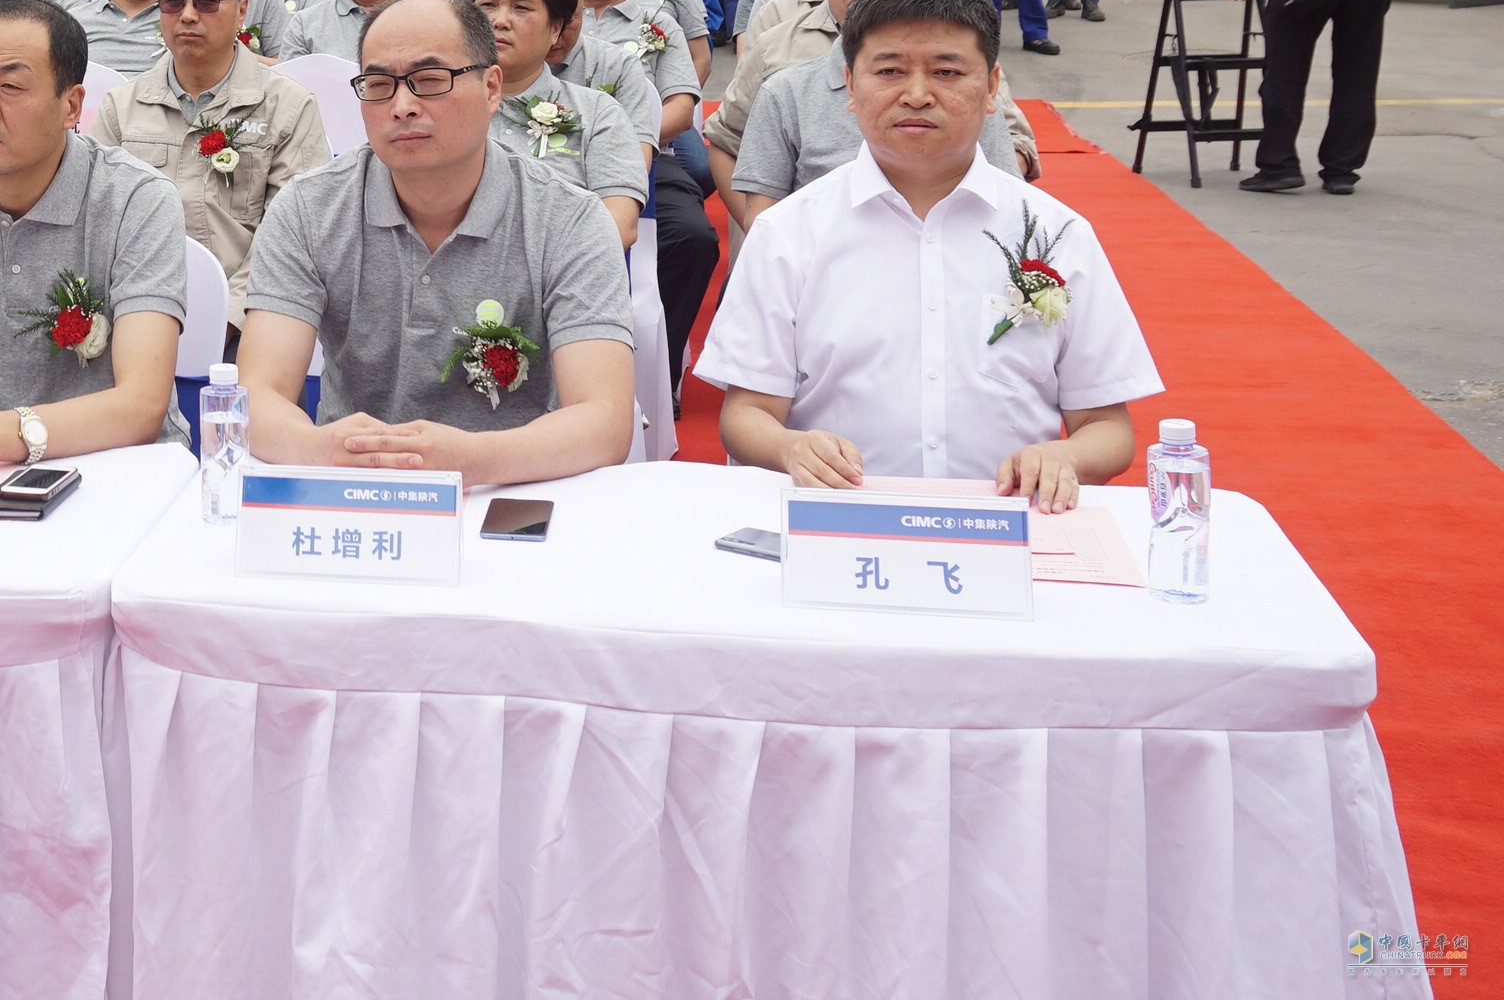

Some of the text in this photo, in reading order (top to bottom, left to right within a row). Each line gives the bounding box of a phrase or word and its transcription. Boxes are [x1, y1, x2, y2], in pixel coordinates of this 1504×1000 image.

[343, 488, 439, 503] CIMC 中集陕汽
[901, 515, 1010, 532] CIMC 中集陕汽
[292, 526, 403, 561] 杜增利
[854, 556, 963, 595] 孔 飞
